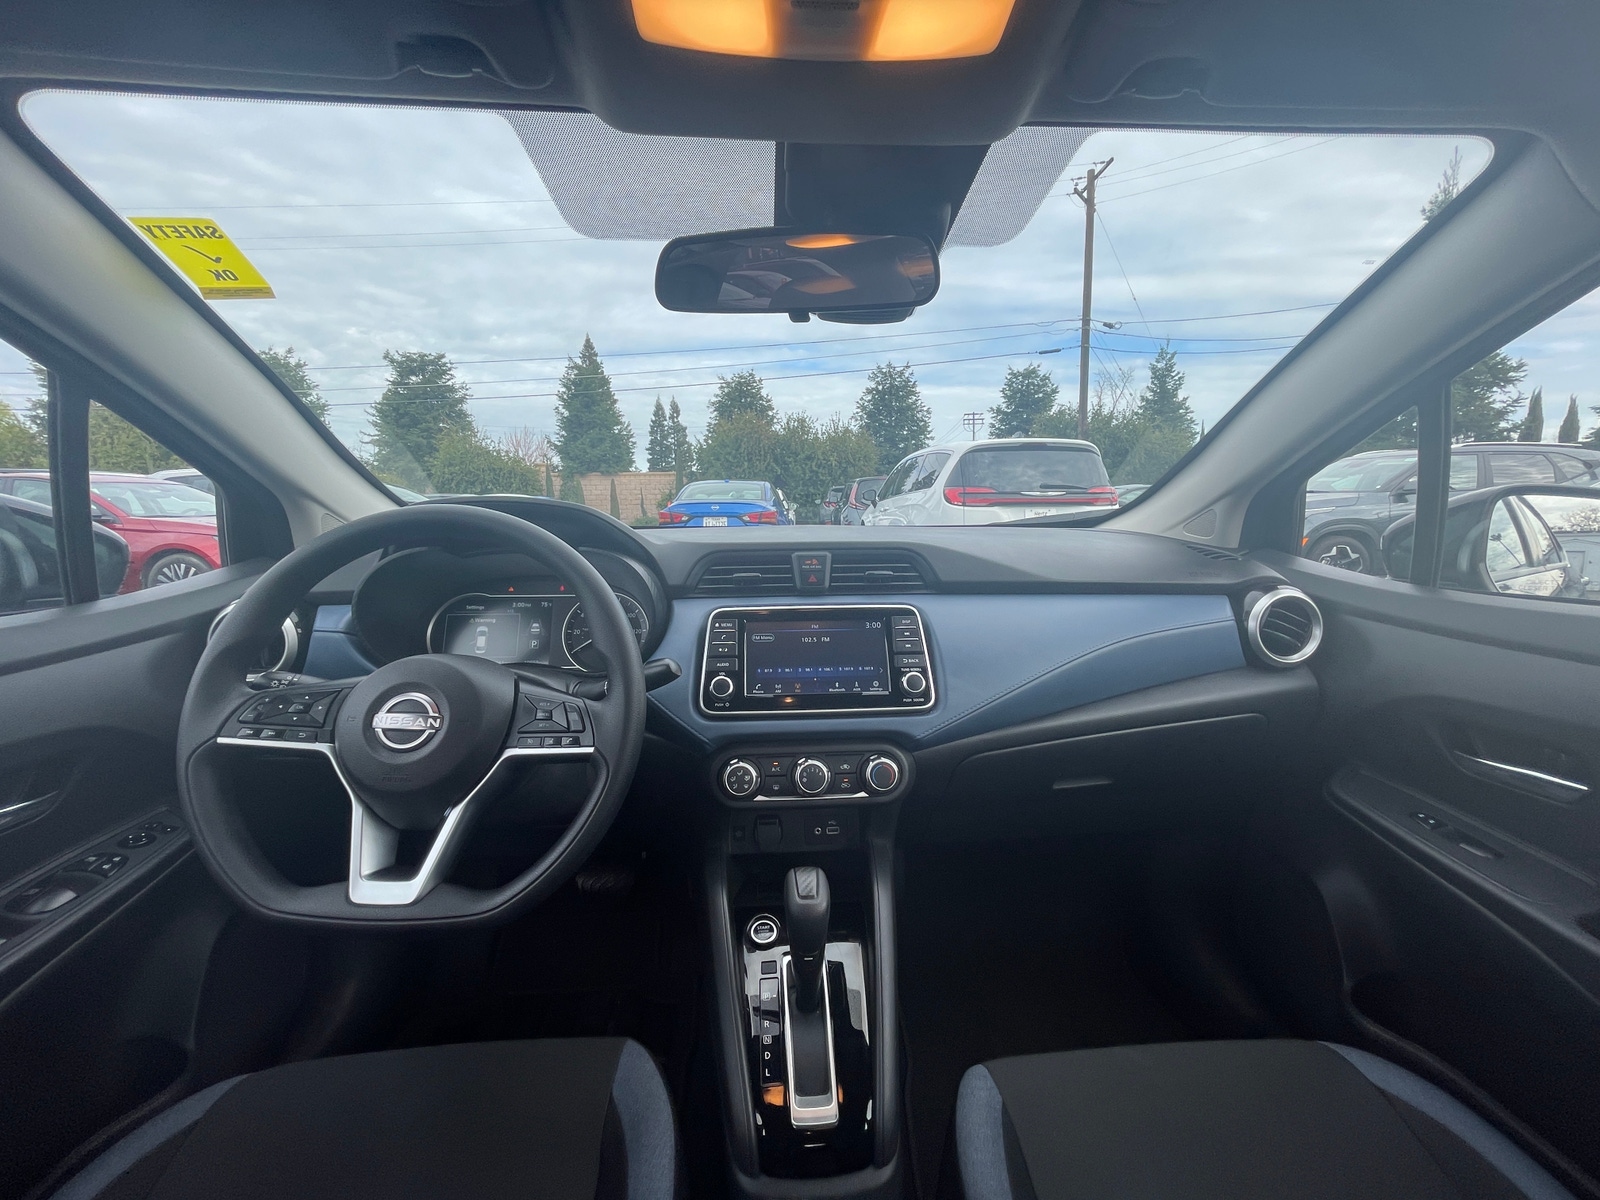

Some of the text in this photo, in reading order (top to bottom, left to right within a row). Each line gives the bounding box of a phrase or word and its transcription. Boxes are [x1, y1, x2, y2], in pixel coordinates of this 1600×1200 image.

[865, 621, 882, 629] 3:00
[531, 640, 538, 649] P
[373, 716, 441, 728] NISSAN
[764, 1020, 770, 1029] R
[764, 1036, 770, 1044] N
[764, 1051, 771, 1060] D
[765, 1068, 771, 1077] L
